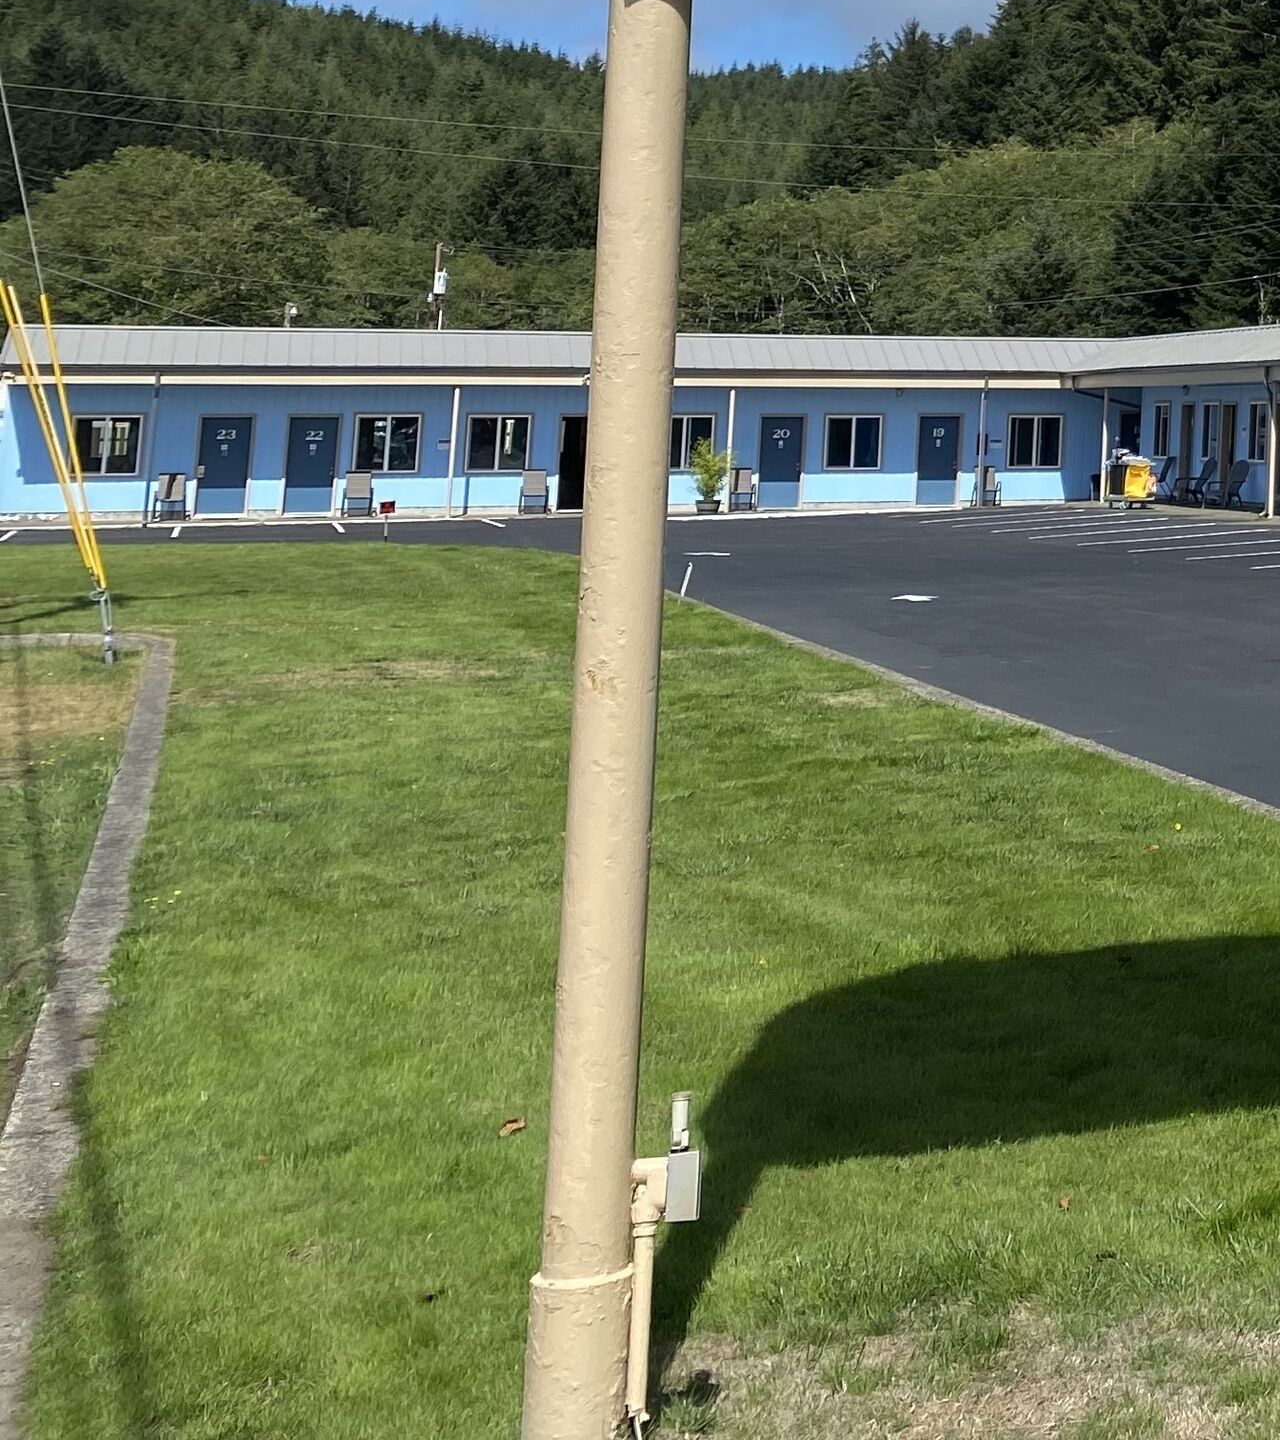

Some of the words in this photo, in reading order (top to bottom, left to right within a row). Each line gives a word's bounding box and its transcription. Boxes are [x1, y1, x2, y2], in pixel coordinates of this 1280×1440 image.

[216, 429, 237, 440] 23
[305, 430, 324, 441] 22
[772, 428, 790, 439] 20
